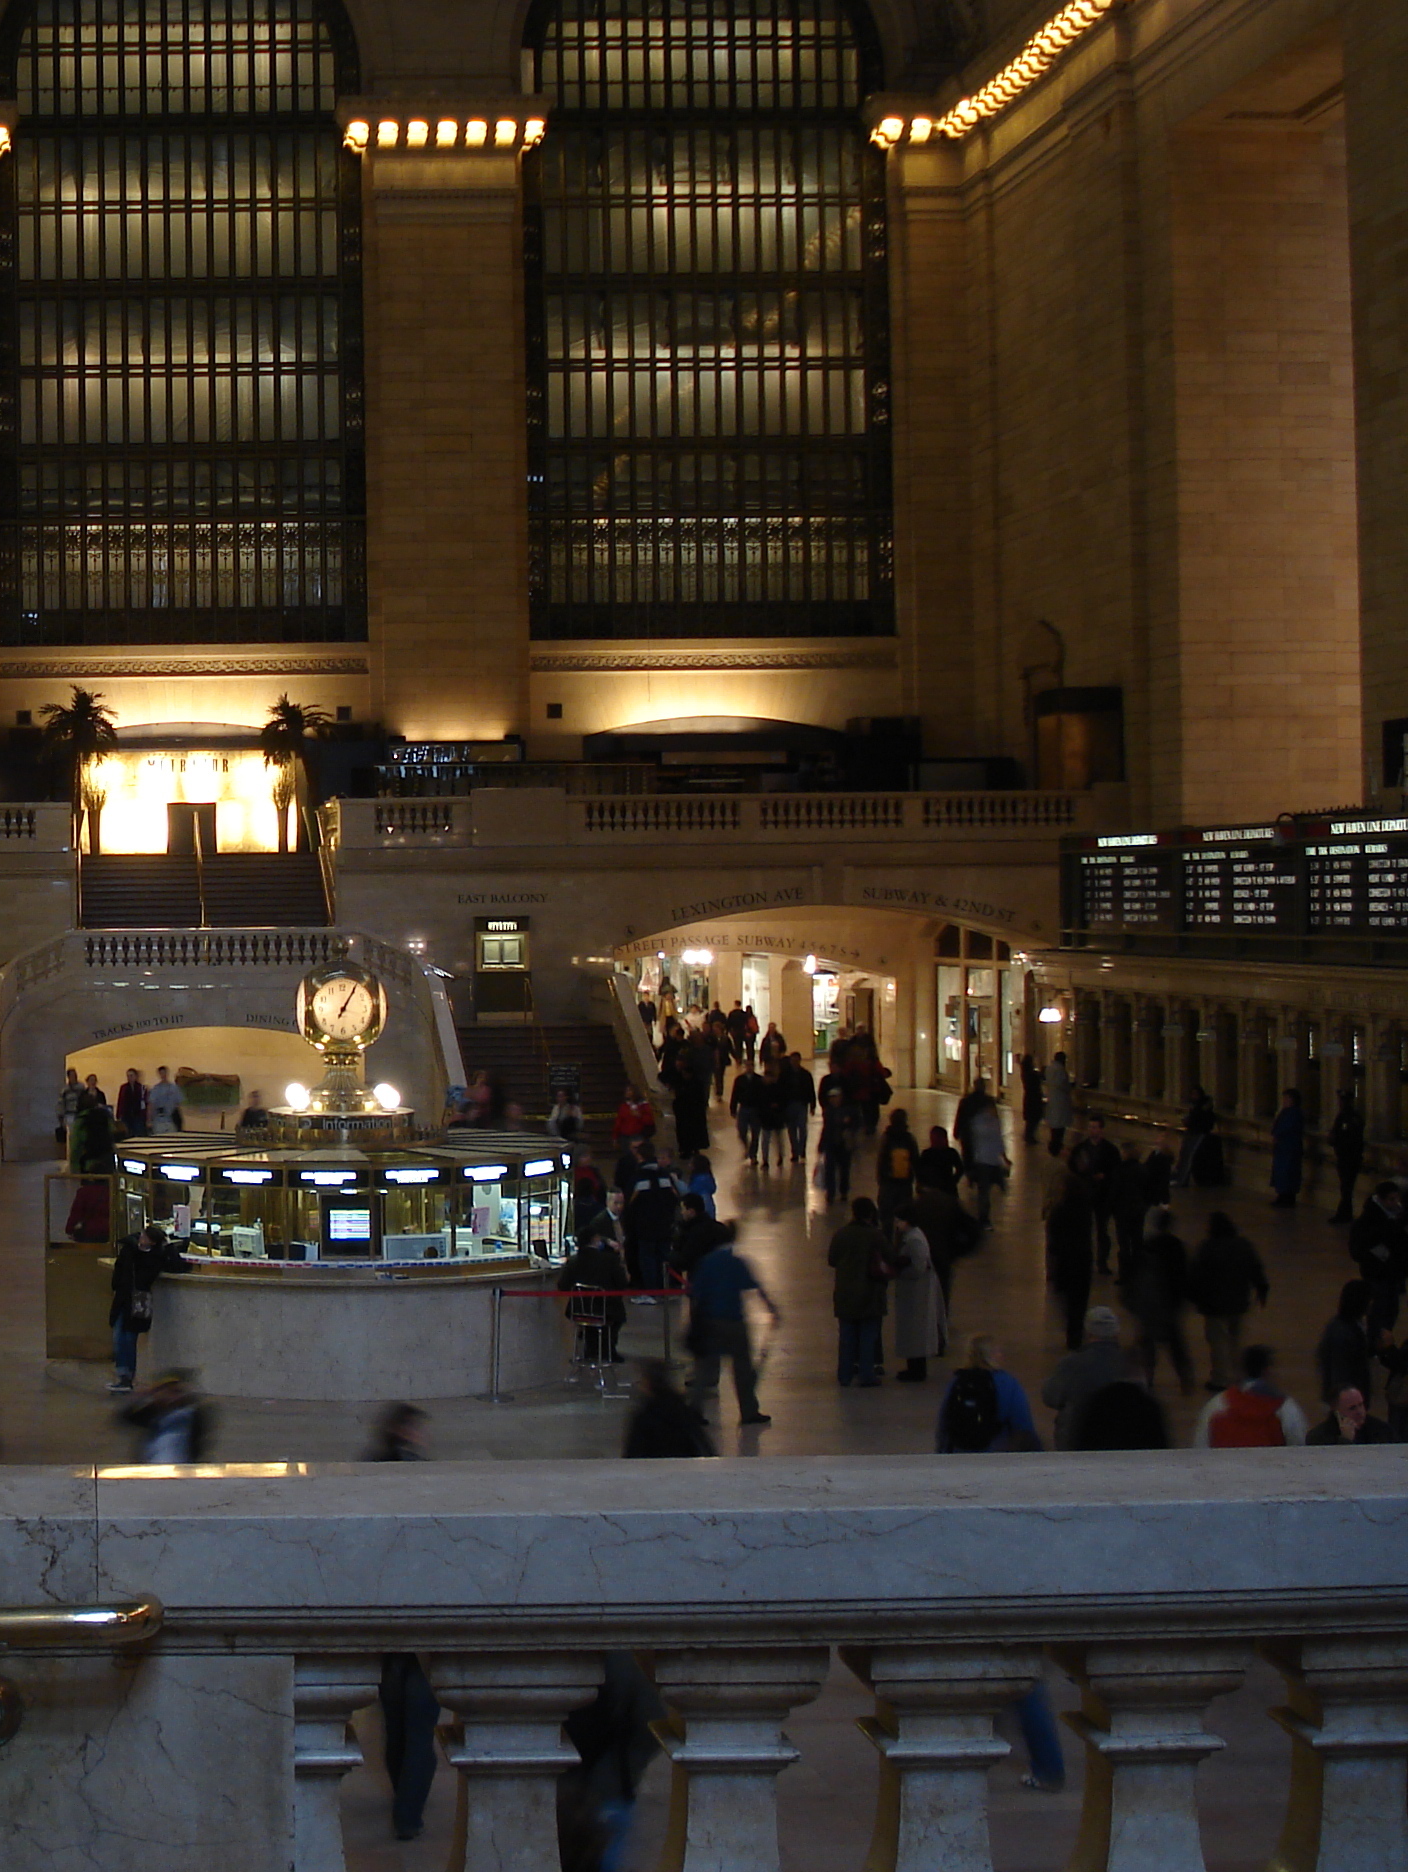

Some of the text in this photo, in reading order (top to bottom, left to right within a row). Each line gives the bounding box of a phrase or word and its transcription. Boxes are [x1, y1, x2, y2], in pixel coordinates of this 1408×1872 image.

[458, 893, 549, 904] EAST BALCONY
[672, 887, 804, 921] LEXINGTON AVE
[862, 887, 1016, 923] SUBWAY & 42ND ST
[617, 939, 666, 955] STREET
[670, 934, 729, 948] PASSAGE
[737, 934, 795, 949] SUBWAY
[92, 1023, 134, 1039] TRACKS
[152, 1016, 169, 1026] TO
[246, 1013, 290, 1026] DINING
[322, 1117, 392, 1130] Information
